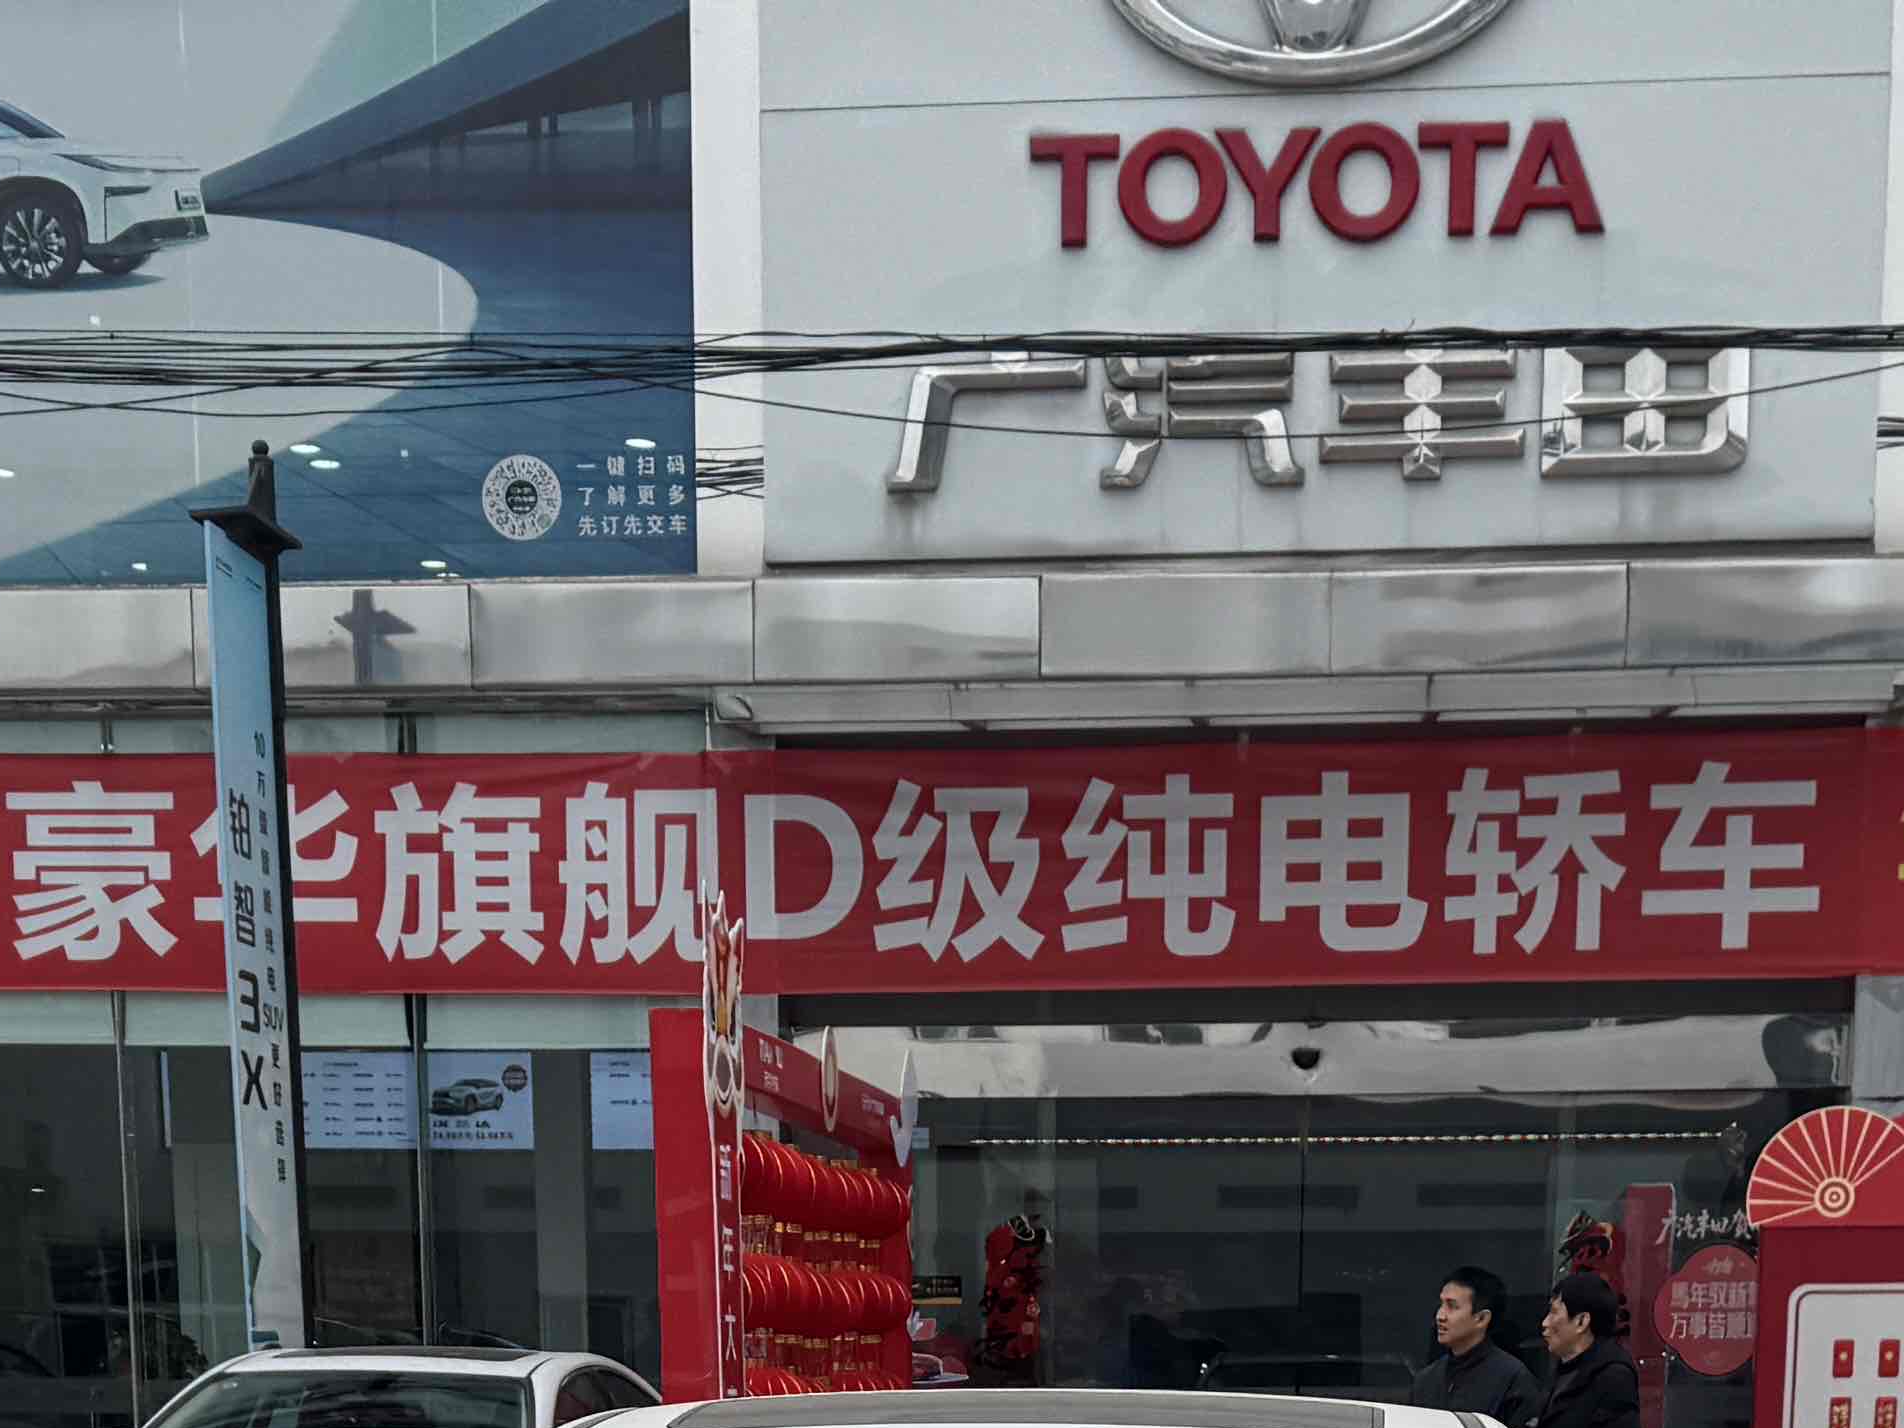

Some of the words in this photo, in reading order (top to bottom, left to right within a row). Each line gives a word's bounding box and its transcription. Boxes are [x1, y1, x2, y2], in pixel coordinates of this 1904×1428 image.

[1029, 117, 1606, 250] TOYOTA
[886, 344, 1751, 494] 广汽丰田
[576, 455, 685, 477] 一键扫码
[577, 485, 686, 507] 了解更多
[578, 515, 688, 537] 先订先交车
[229, 787, 268, 1111] 铂智3X
